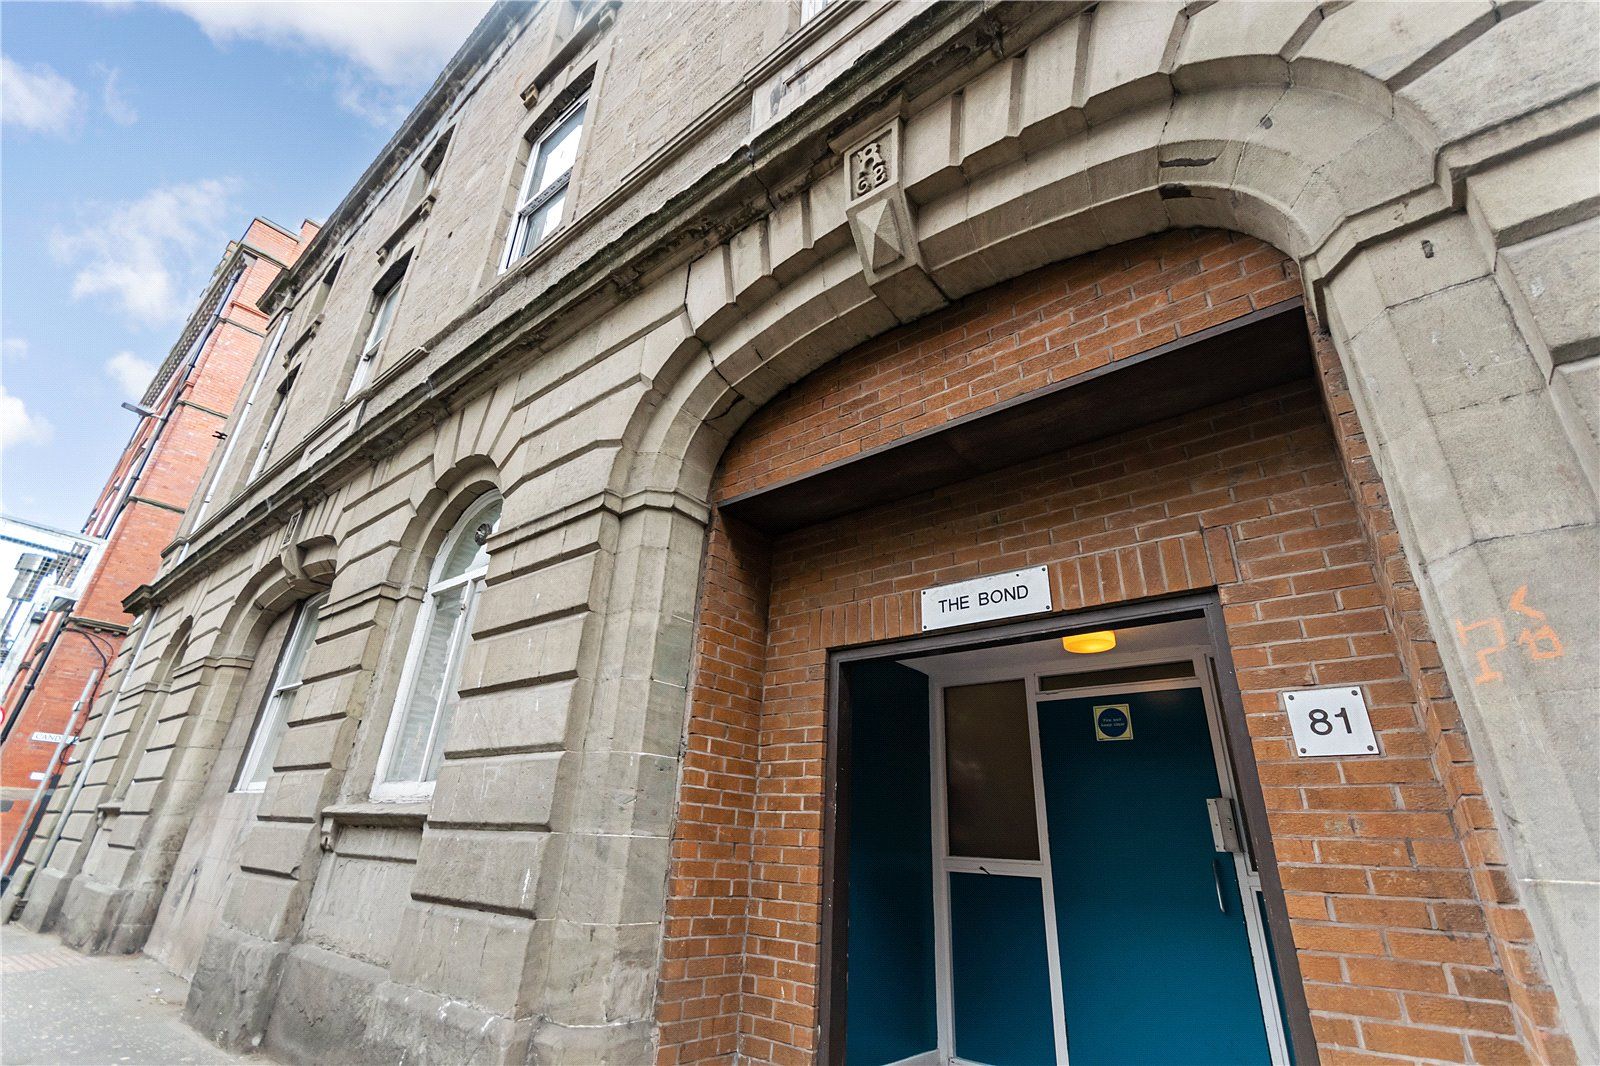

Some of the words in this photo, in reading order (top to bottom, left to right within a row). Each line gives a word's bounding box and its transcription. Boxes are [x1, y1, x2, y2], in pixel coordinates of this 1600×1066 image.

[938, 595, 970, 613] THE
[978, 585, 1029, 606] BOND
[1308, 707, 1353, 736] 81
